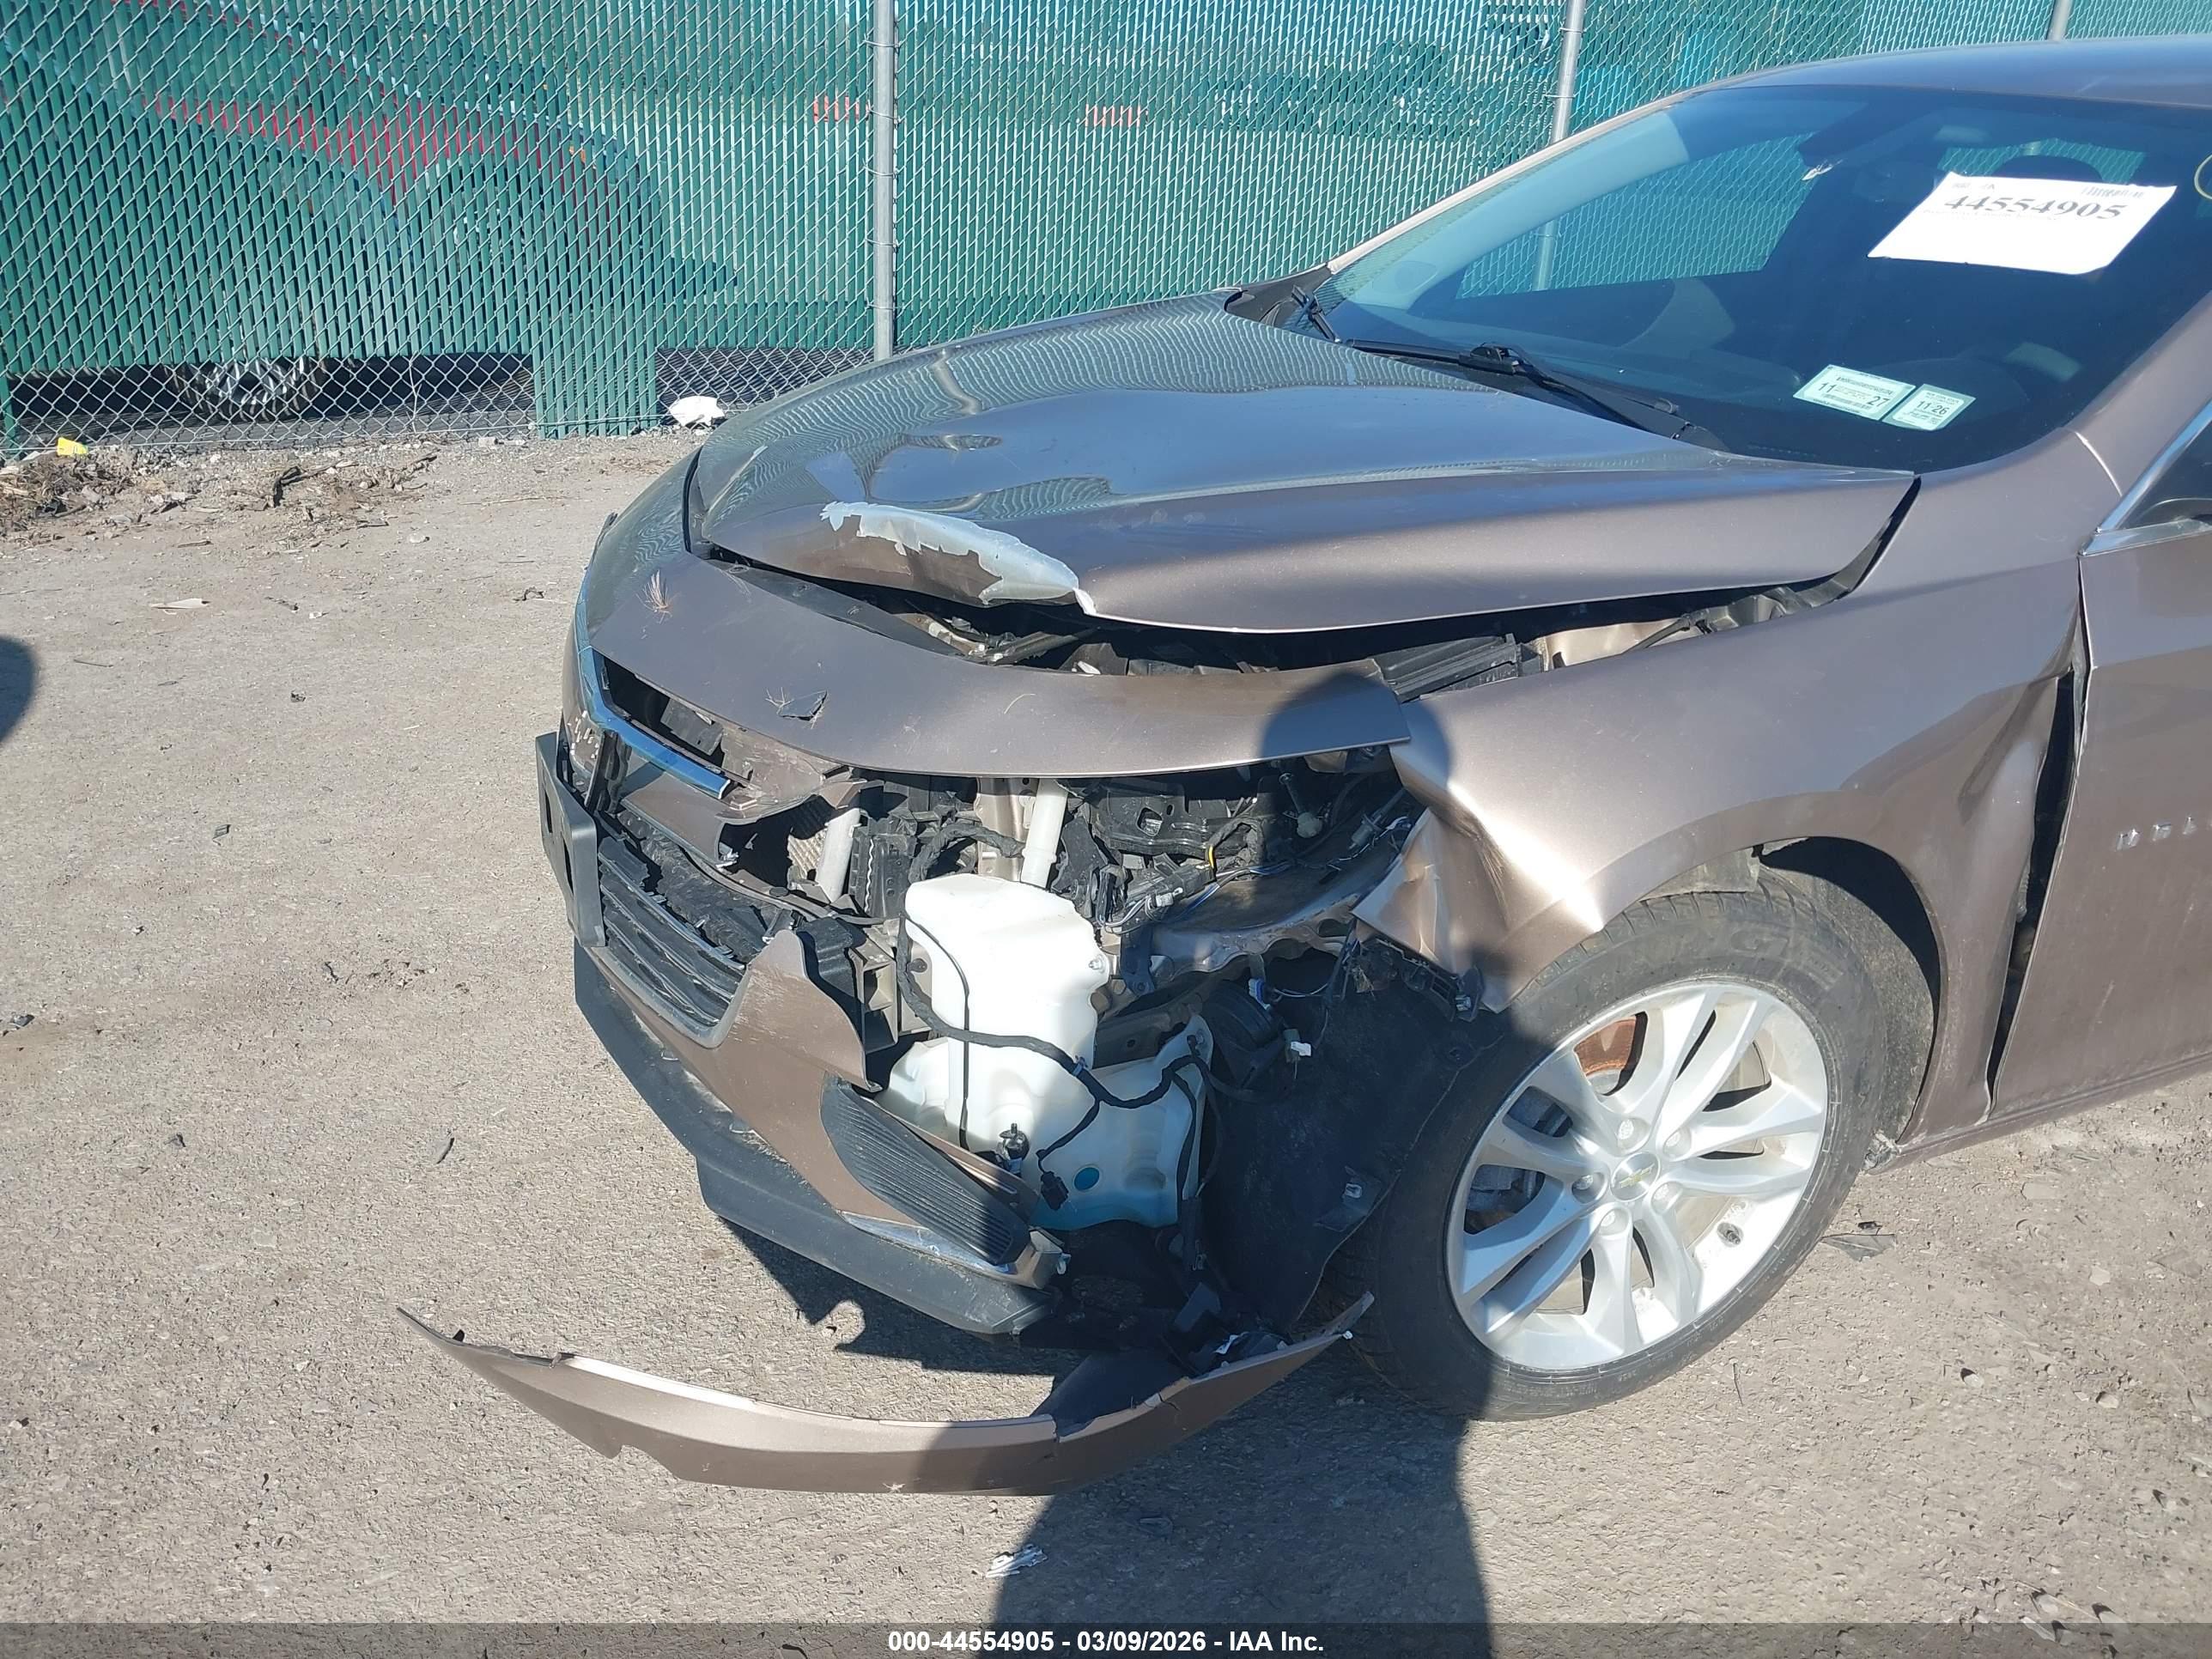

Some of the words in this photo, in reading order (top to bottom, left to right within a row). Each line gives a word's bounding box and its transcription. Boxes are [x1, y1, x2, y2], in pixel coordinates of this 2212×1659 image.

[1944, 195, 2128, 219] 44554905
[1818, 381, 1837, 393] 11
[1867, 395, 1891, 407] 27
